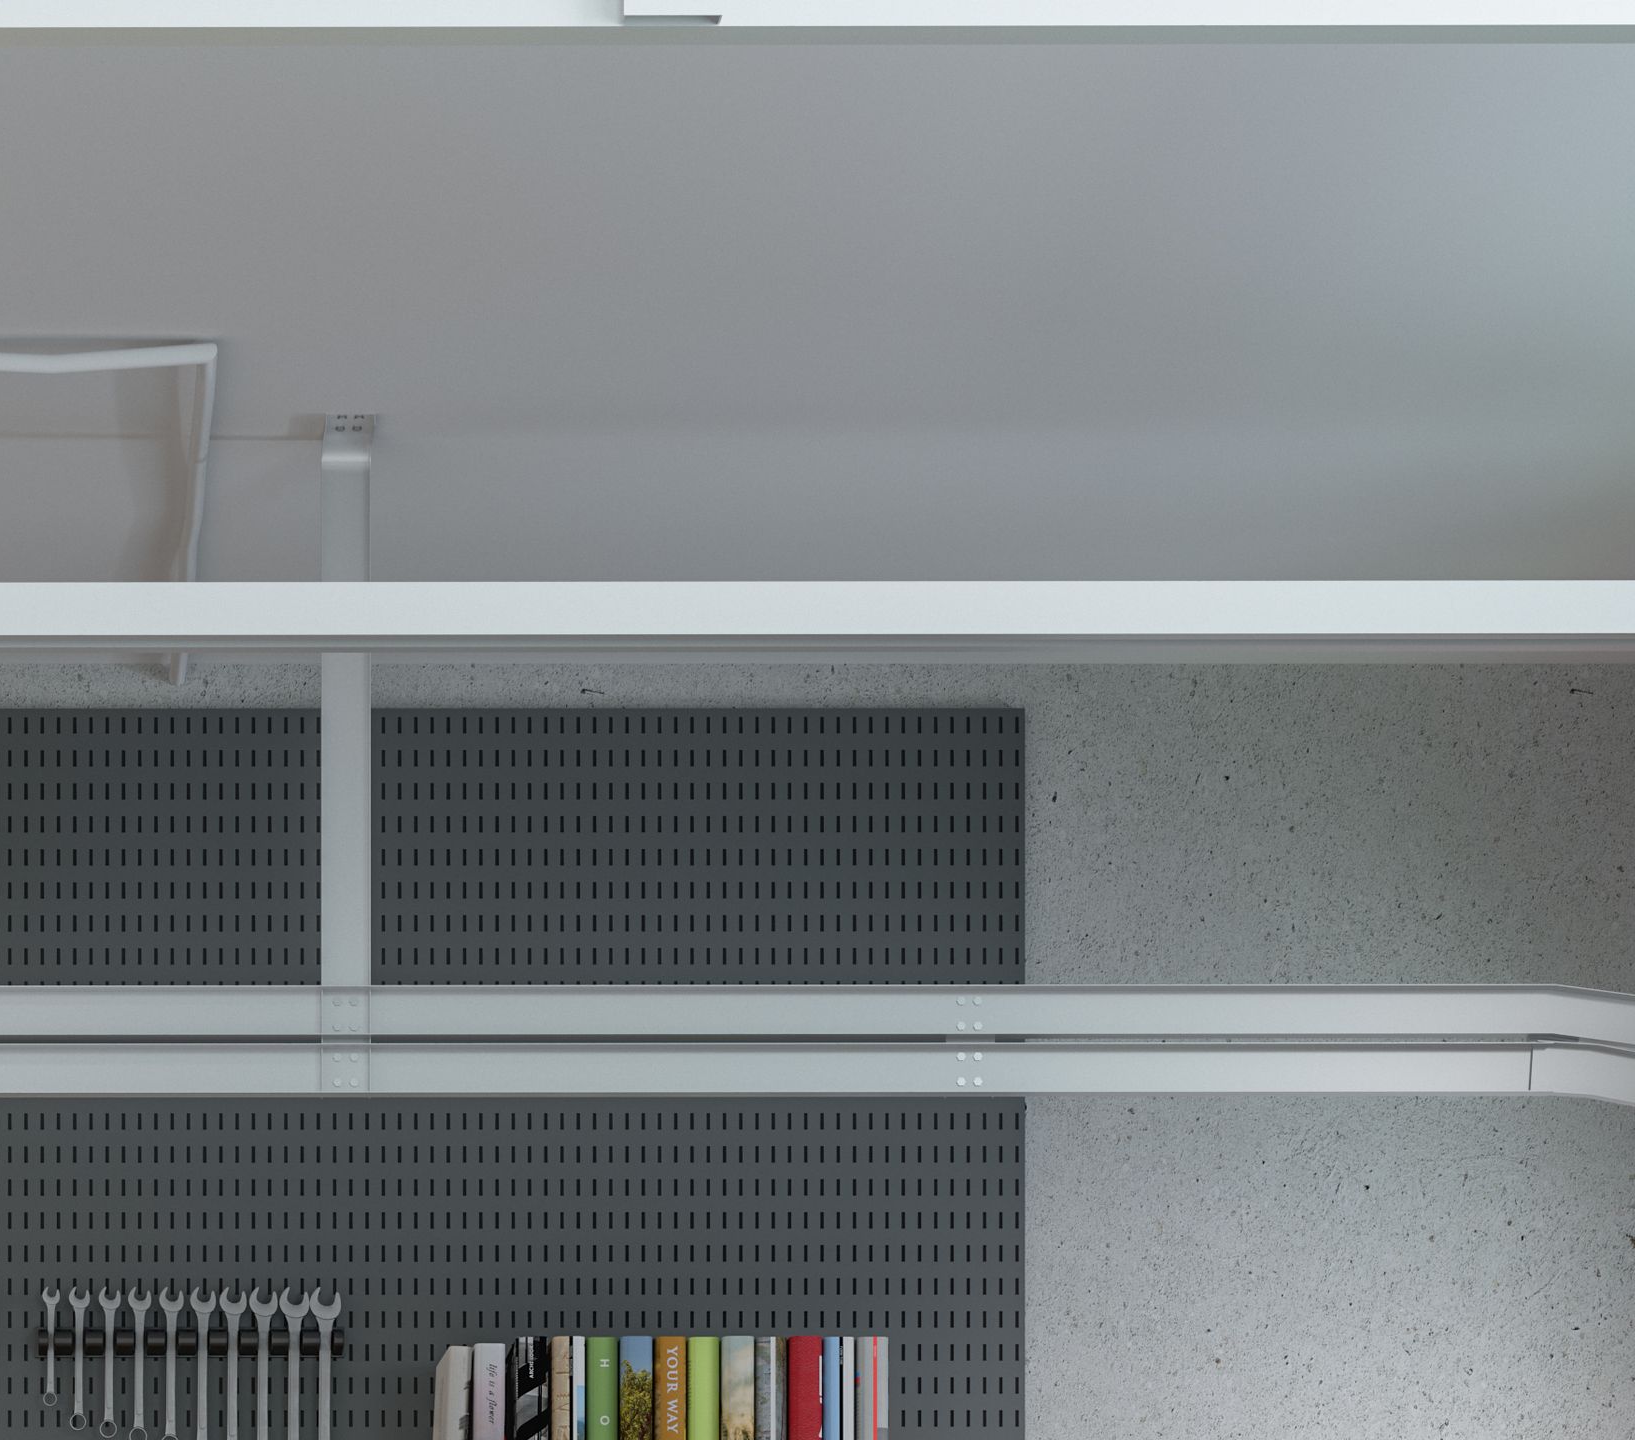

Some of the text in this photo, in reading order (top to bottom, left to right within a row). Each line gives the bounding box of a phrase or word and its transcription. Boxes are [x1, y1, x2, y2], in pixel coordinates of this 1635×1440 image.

[486, 1364, 498, 1378] life
[666, 1345, 679, 1435] YOUR WAY
[486, 1397, 498, 1425] flower
